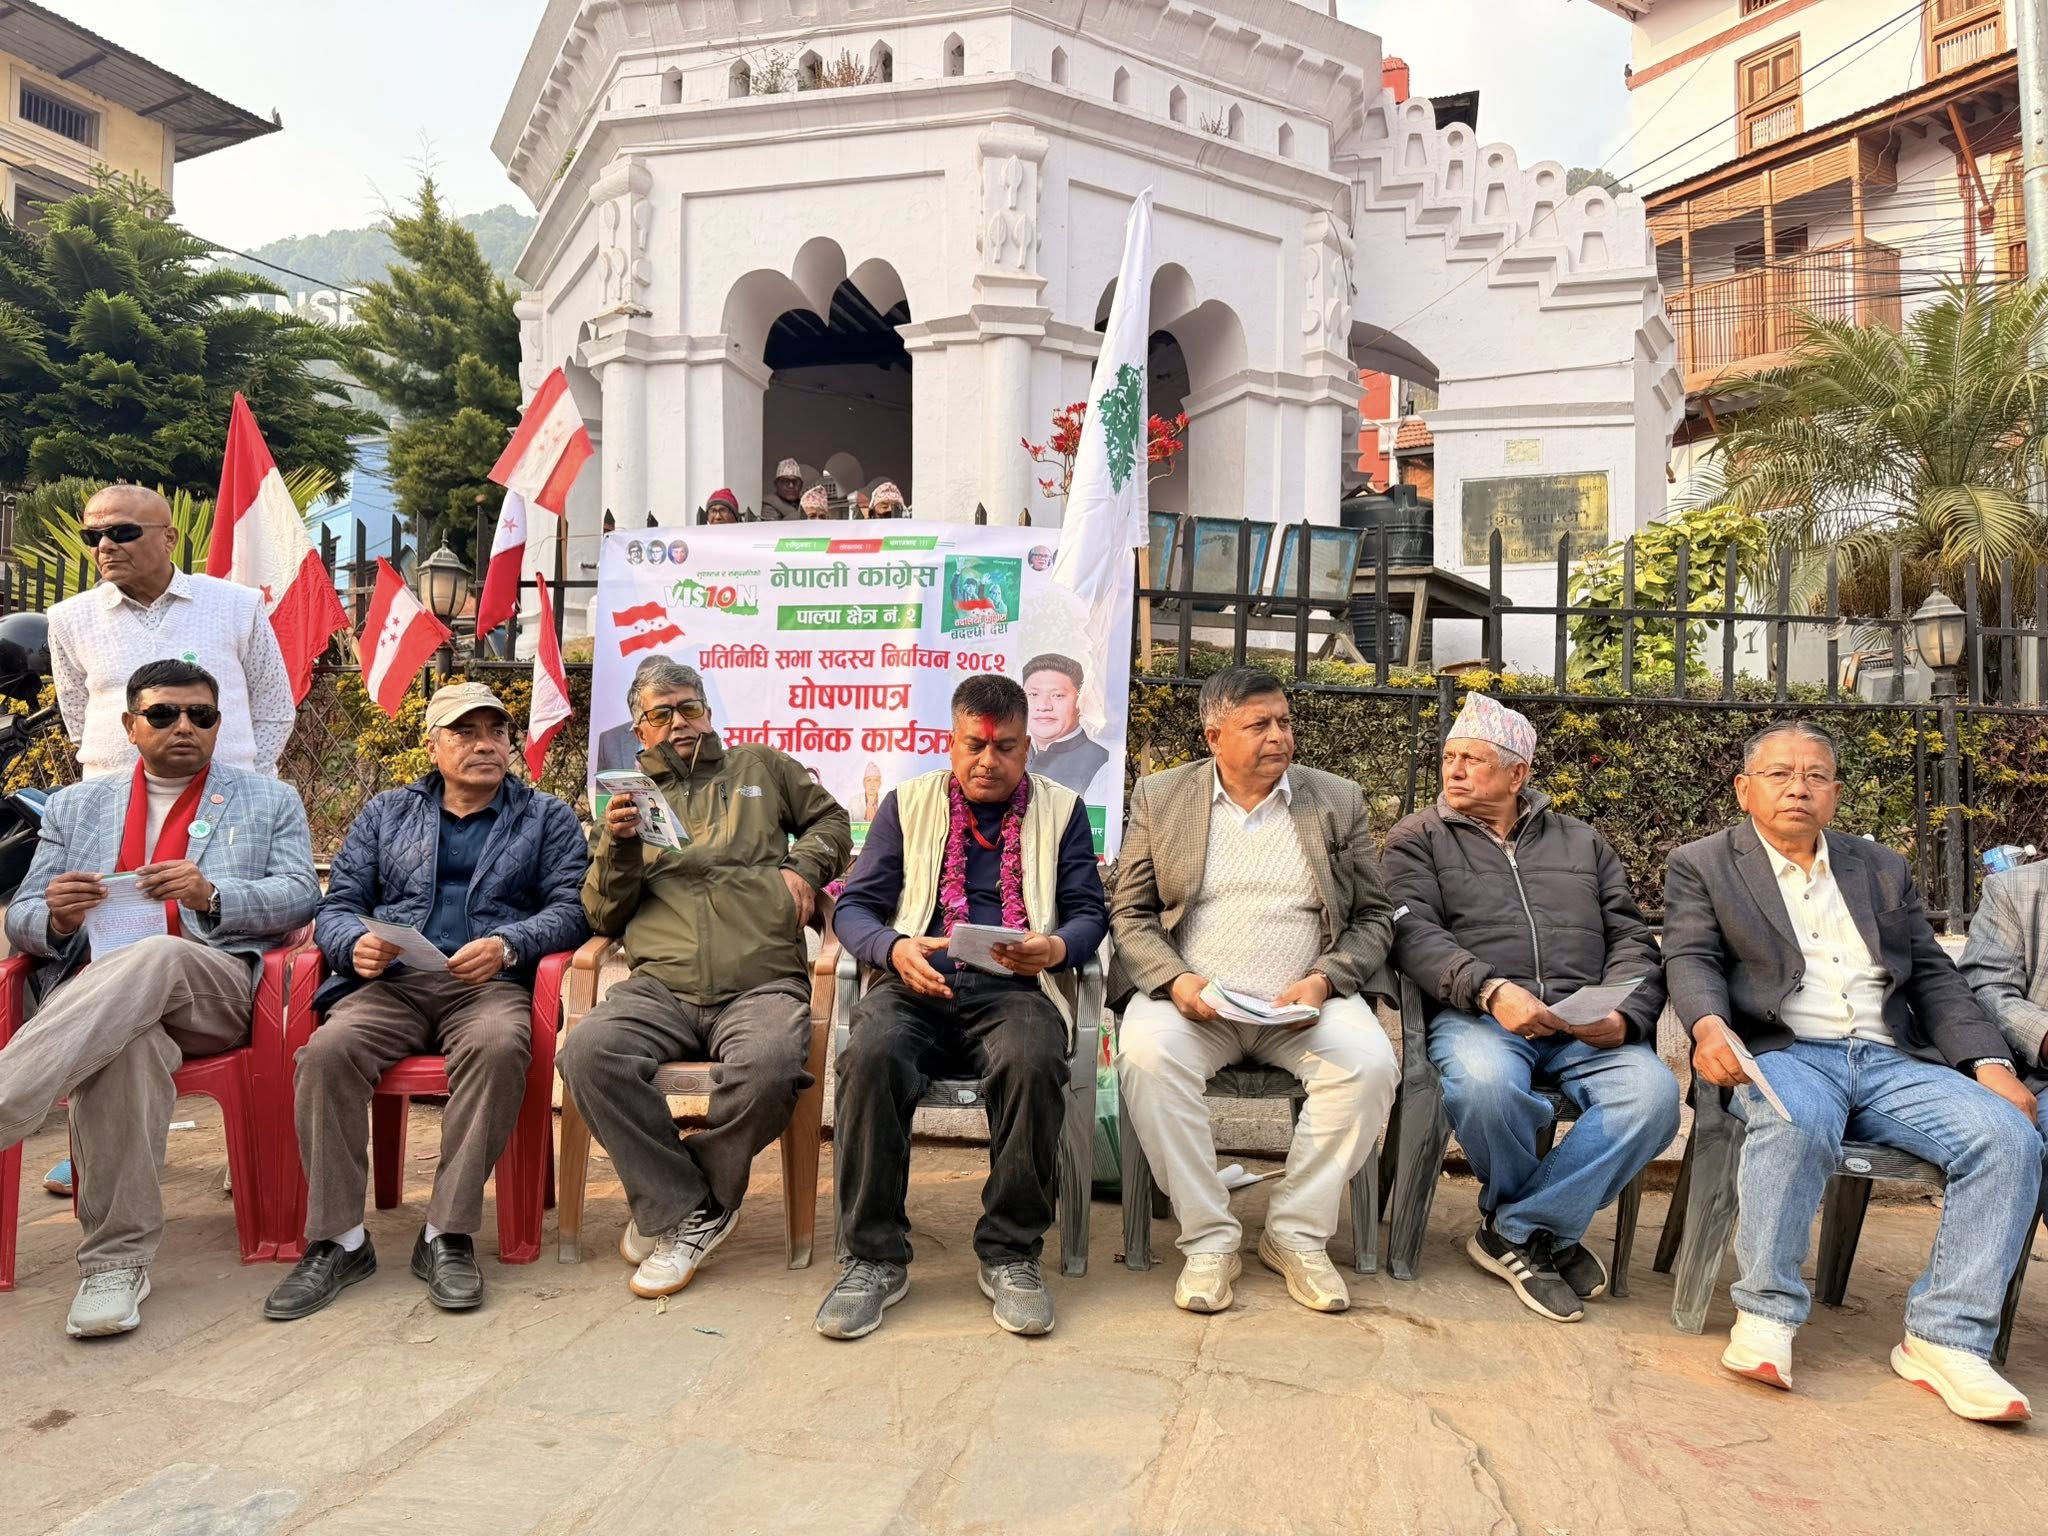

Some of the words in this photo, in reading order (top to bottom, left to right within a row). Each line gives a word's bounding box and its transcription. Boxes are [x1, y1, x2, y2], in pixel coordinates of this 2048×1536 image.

[770, 561, 850, 588] नेपाली
[858, 560, 938, 589] कांग्रेस
[797, 609, 842, 625] पाल्पा
[846, 605, 878, 625] क्षेत्र
[907, 609, 916, 622] २
[699, 644, 768, 671] प्रतिनिधि
[775, 649, 811, 670] सभा
[818, 649, 875, 670] सदस्य
[881, 643, 950, 669] निर्वाचन
[956, 652, 1005, 672] २०८२
[788, 676, 911, 710] घोषणापत्र
[861, 719, 950, 754] कार्यक्र
